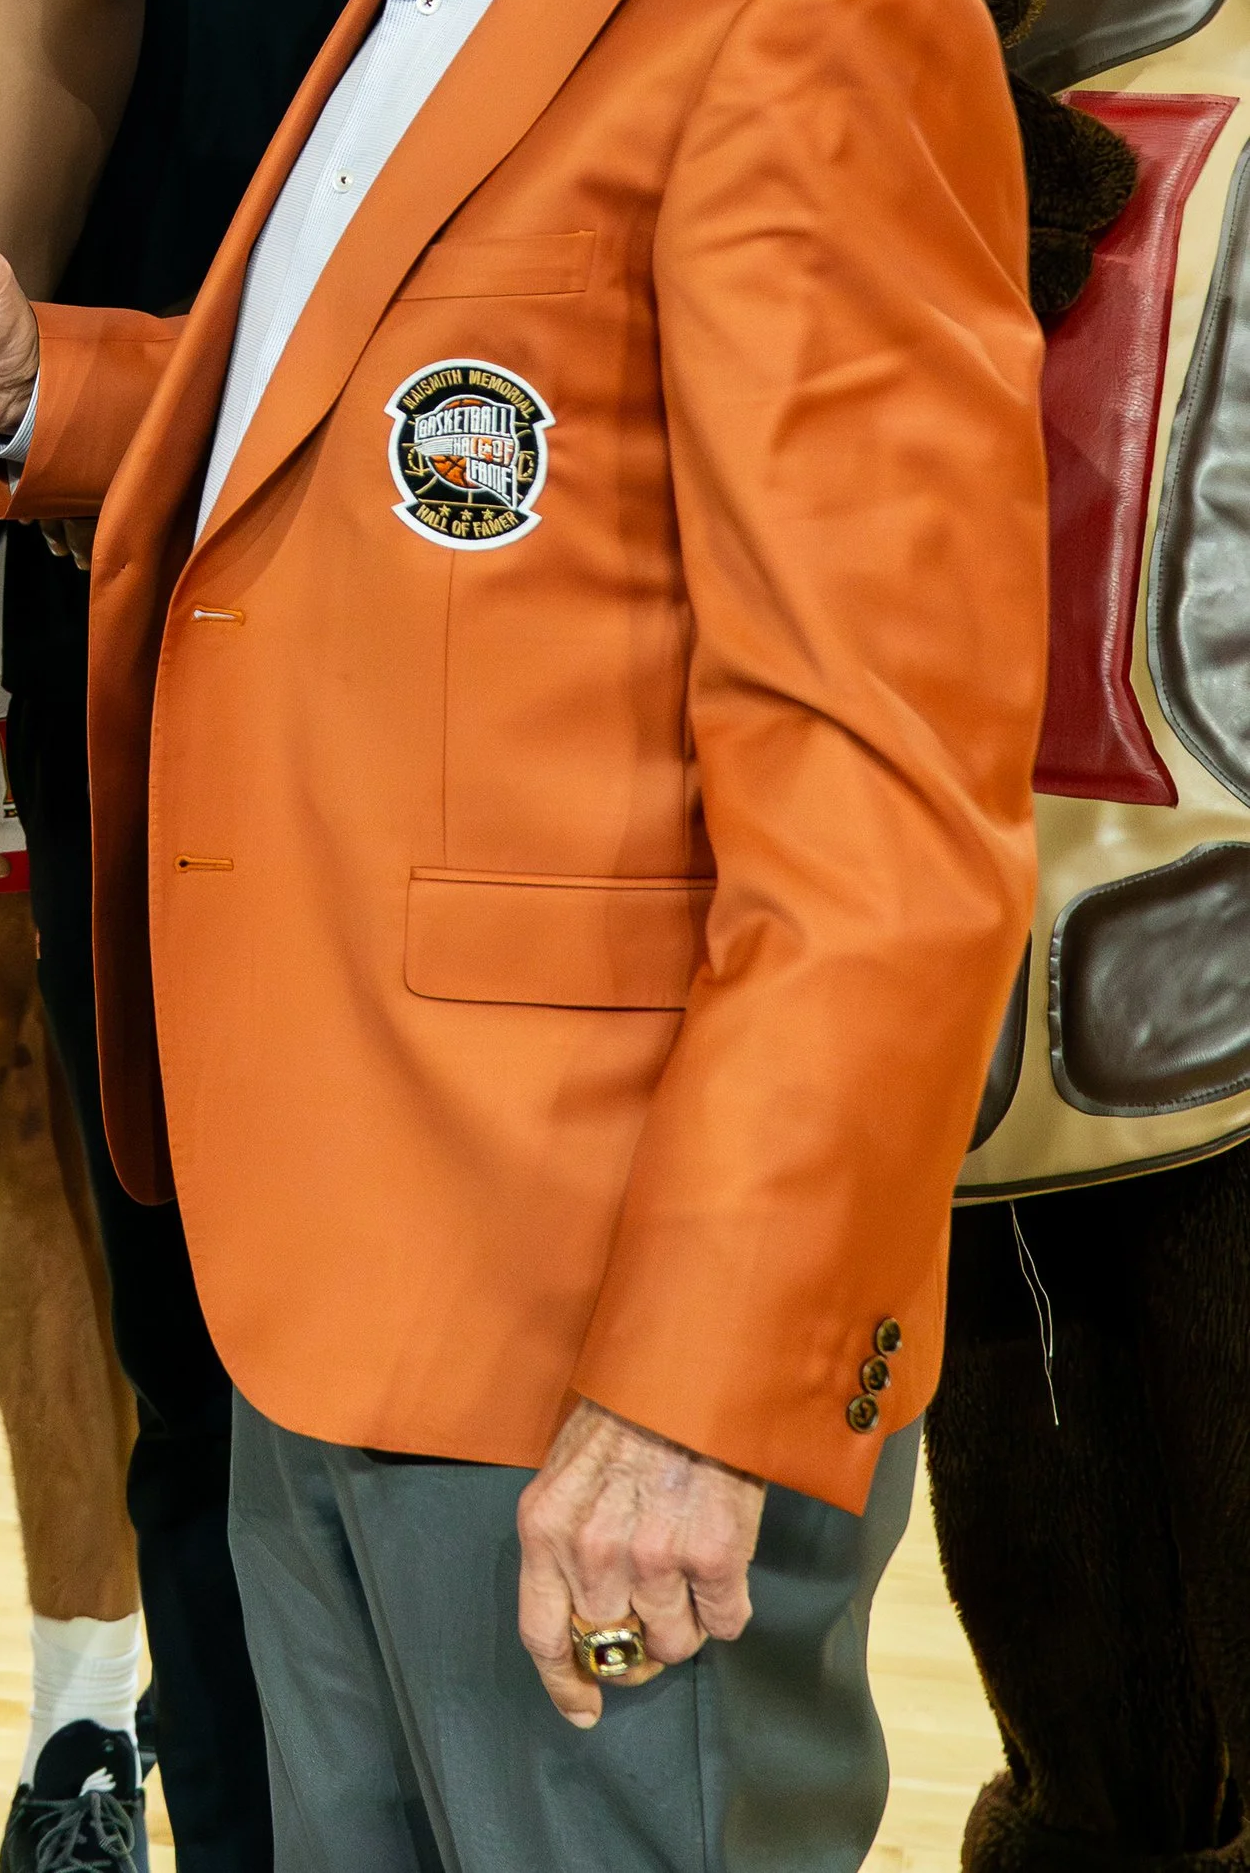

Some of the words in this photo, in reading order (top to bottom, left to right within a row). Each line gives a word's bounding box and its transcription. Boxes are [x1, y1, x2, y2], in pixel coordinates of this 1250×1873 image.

[402, 369, 463, 410] NAISMITH
[468, 369, 537, 420] MEMORIAL
[418, 405, 512, 438] BASKETBALL
[452, 437, 487, 460] HALL
[491, 439, 514, 466] OF
[471, 459, 513, 500] FAME
[415, 504, 450, 534] HALL
[451, 522, 470, 538] OF
[473, 510, 519, 538] FAMER
